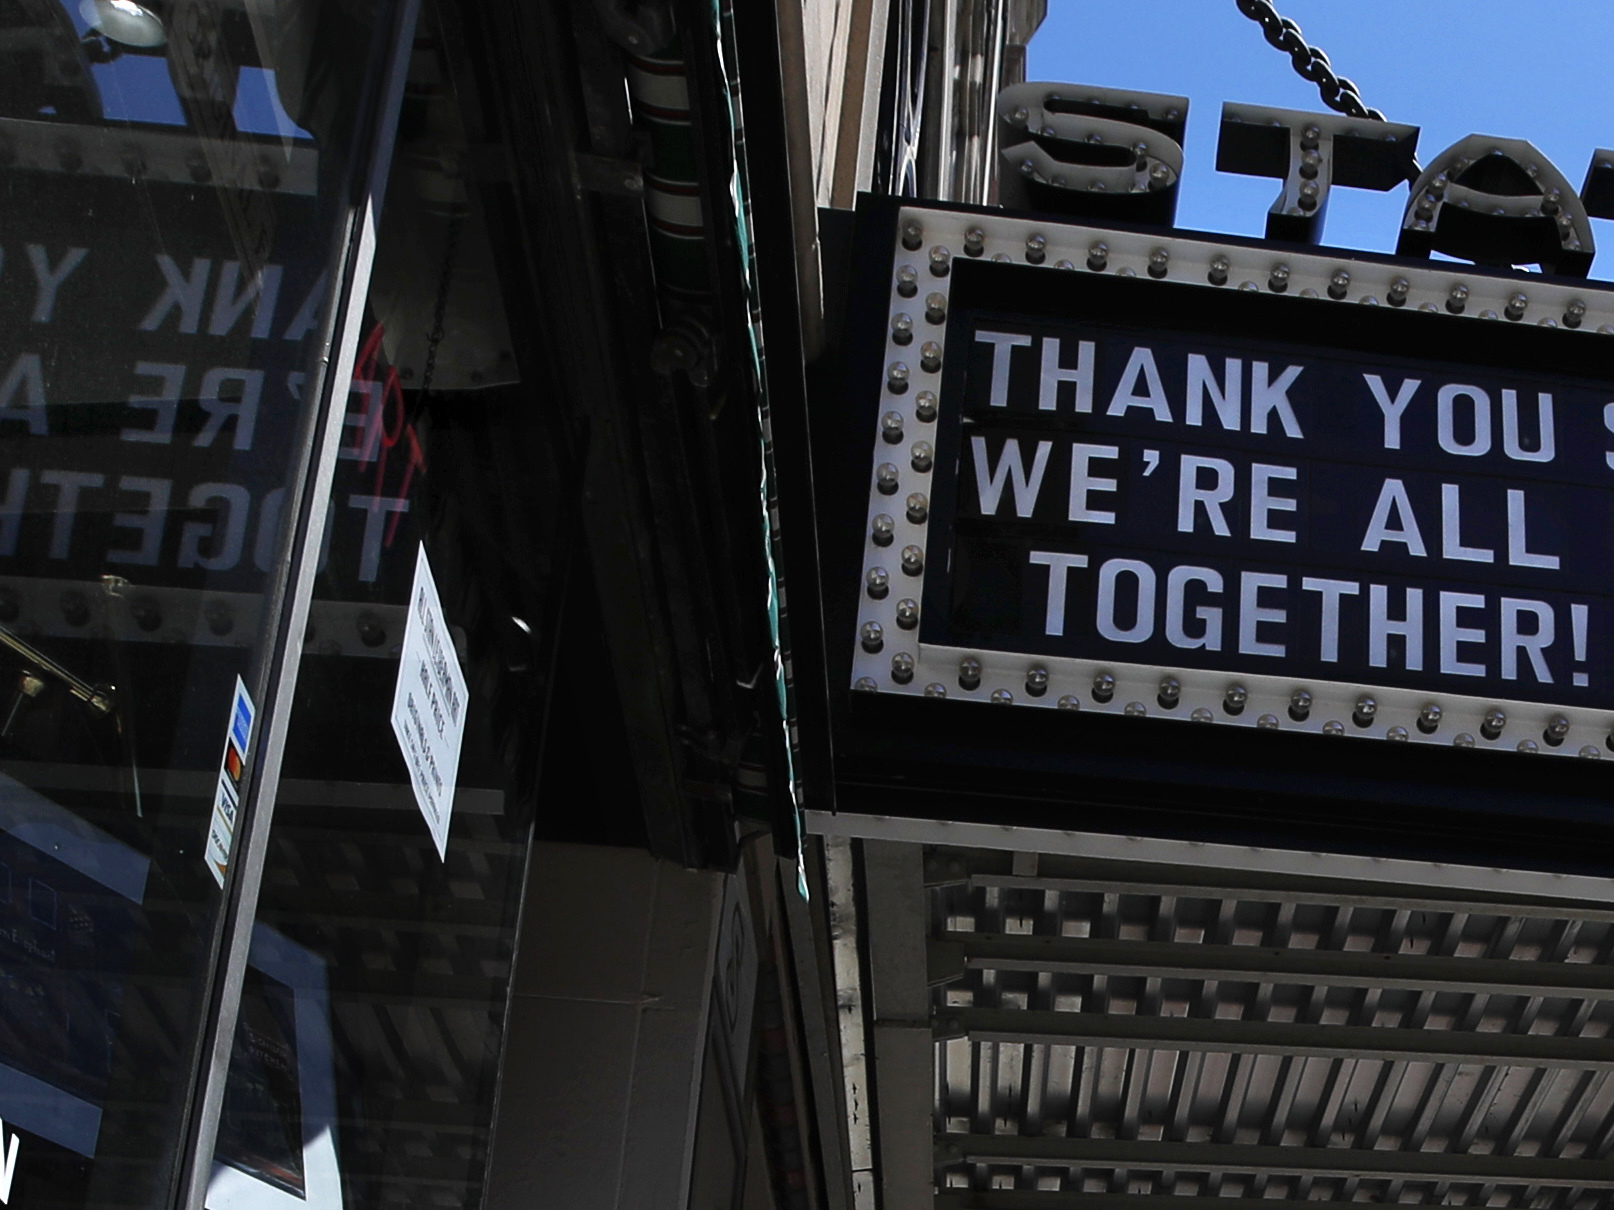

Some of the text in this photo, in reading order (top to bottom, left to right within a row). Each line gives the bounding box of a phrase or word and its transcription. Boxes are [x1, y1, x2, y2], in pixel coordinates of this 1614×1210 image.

[974, 330, 1306, 440] THANK
[1362, 373, 1556, 463] YOU
[970, 435, 1299, 544] WE'RE
[1361, 477, 1561, 571] ALL
[1029, 549, 1589, 688] TOGETHER!
